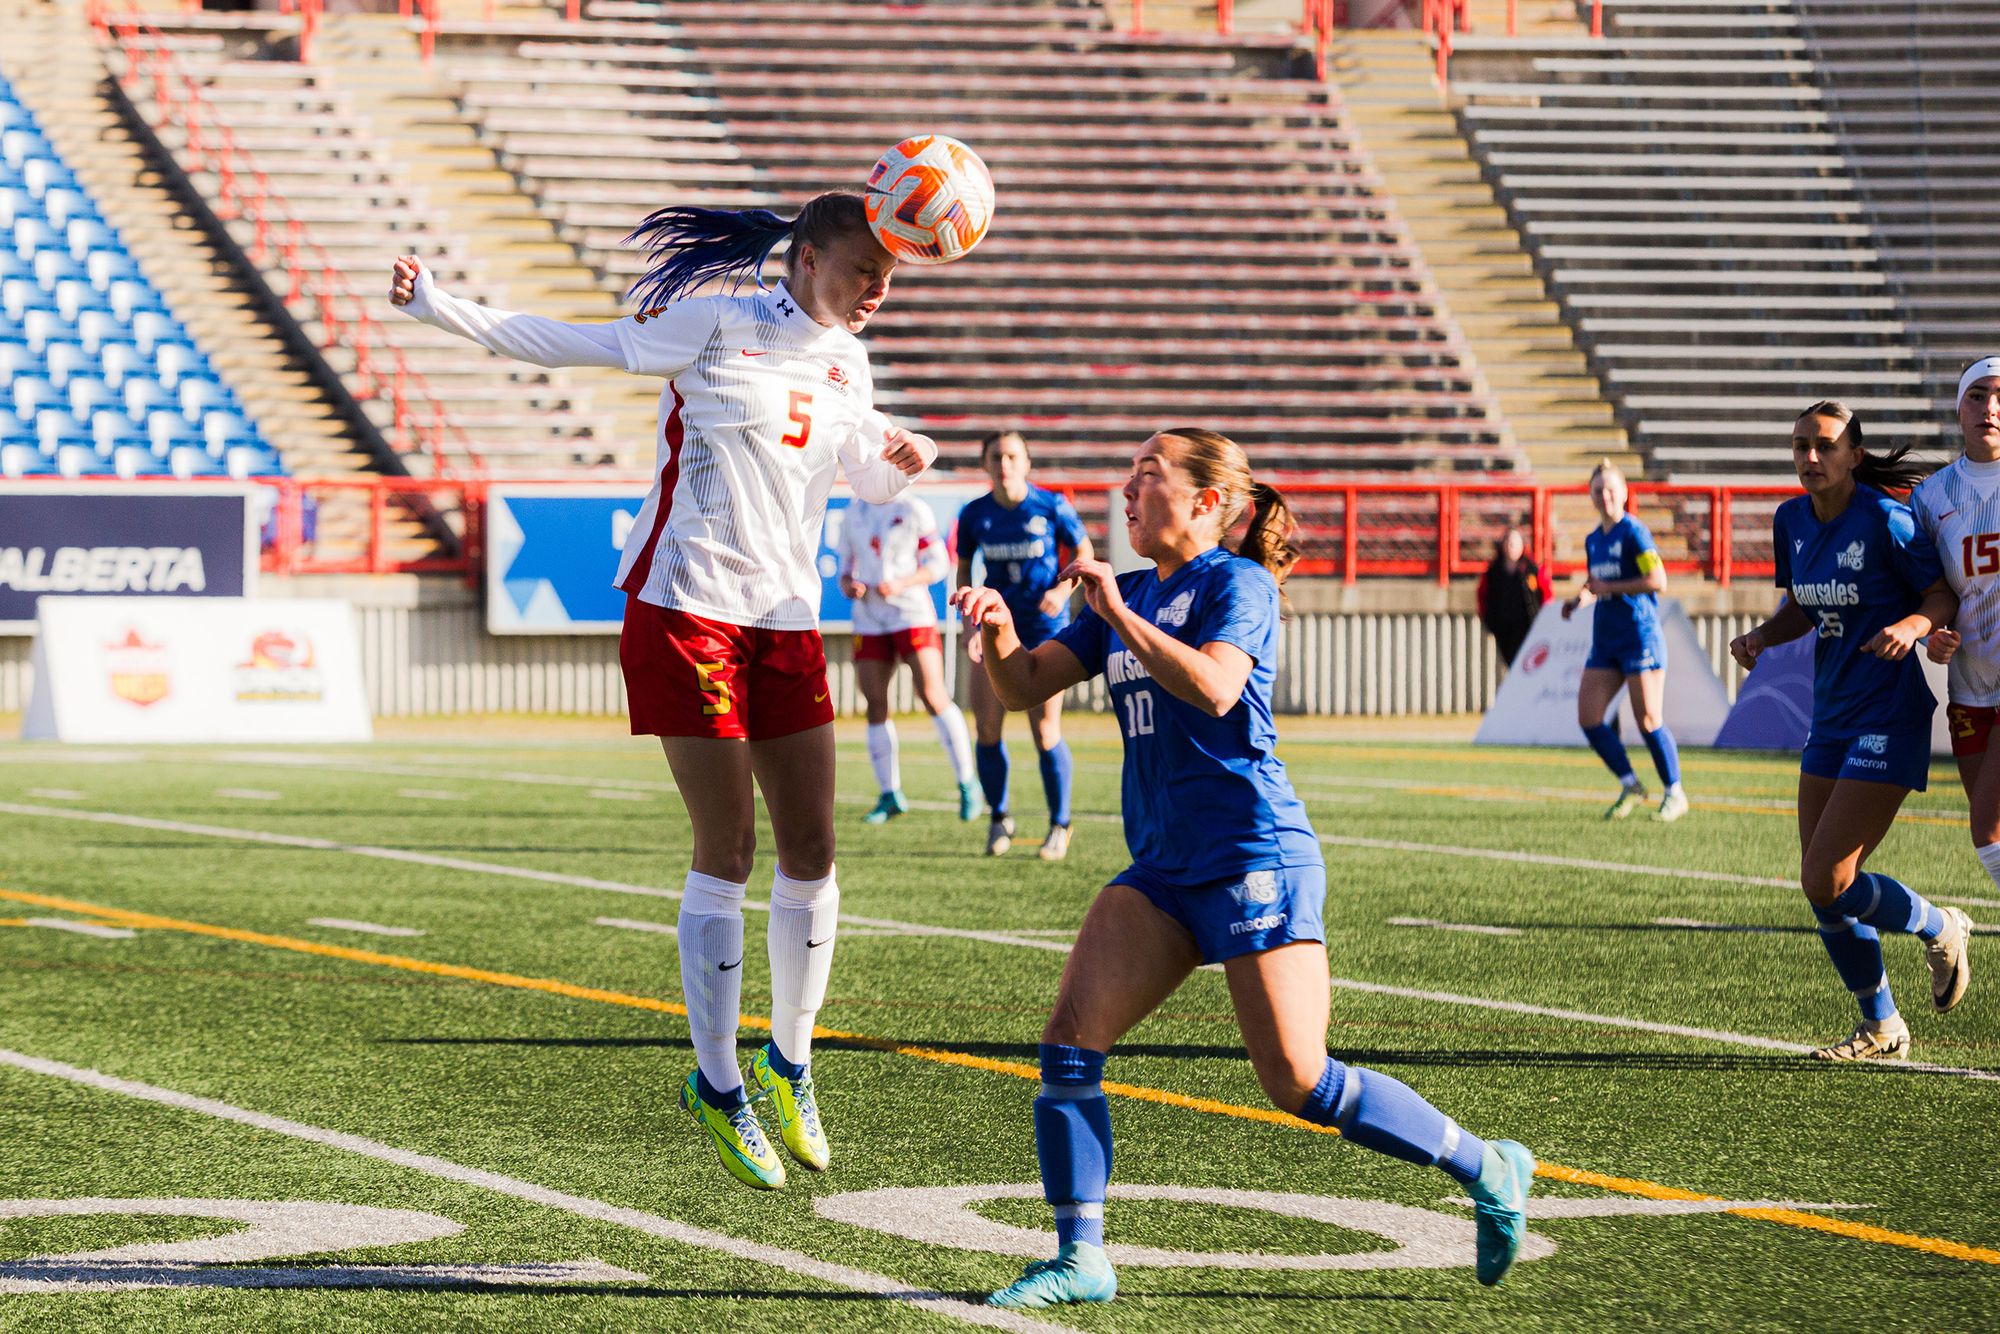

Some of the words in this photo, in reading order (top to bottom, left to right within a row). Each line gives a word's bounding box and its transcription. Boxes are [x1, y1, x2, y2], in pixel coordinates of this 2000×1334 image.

[781, 390, 813, 449] 5
[1962, 532, 2000, 578] 15
[694, 661, 731, 715] 5
[1124, 690, 1155, 738] 10
[1847, 757, 1888, 770] macron
